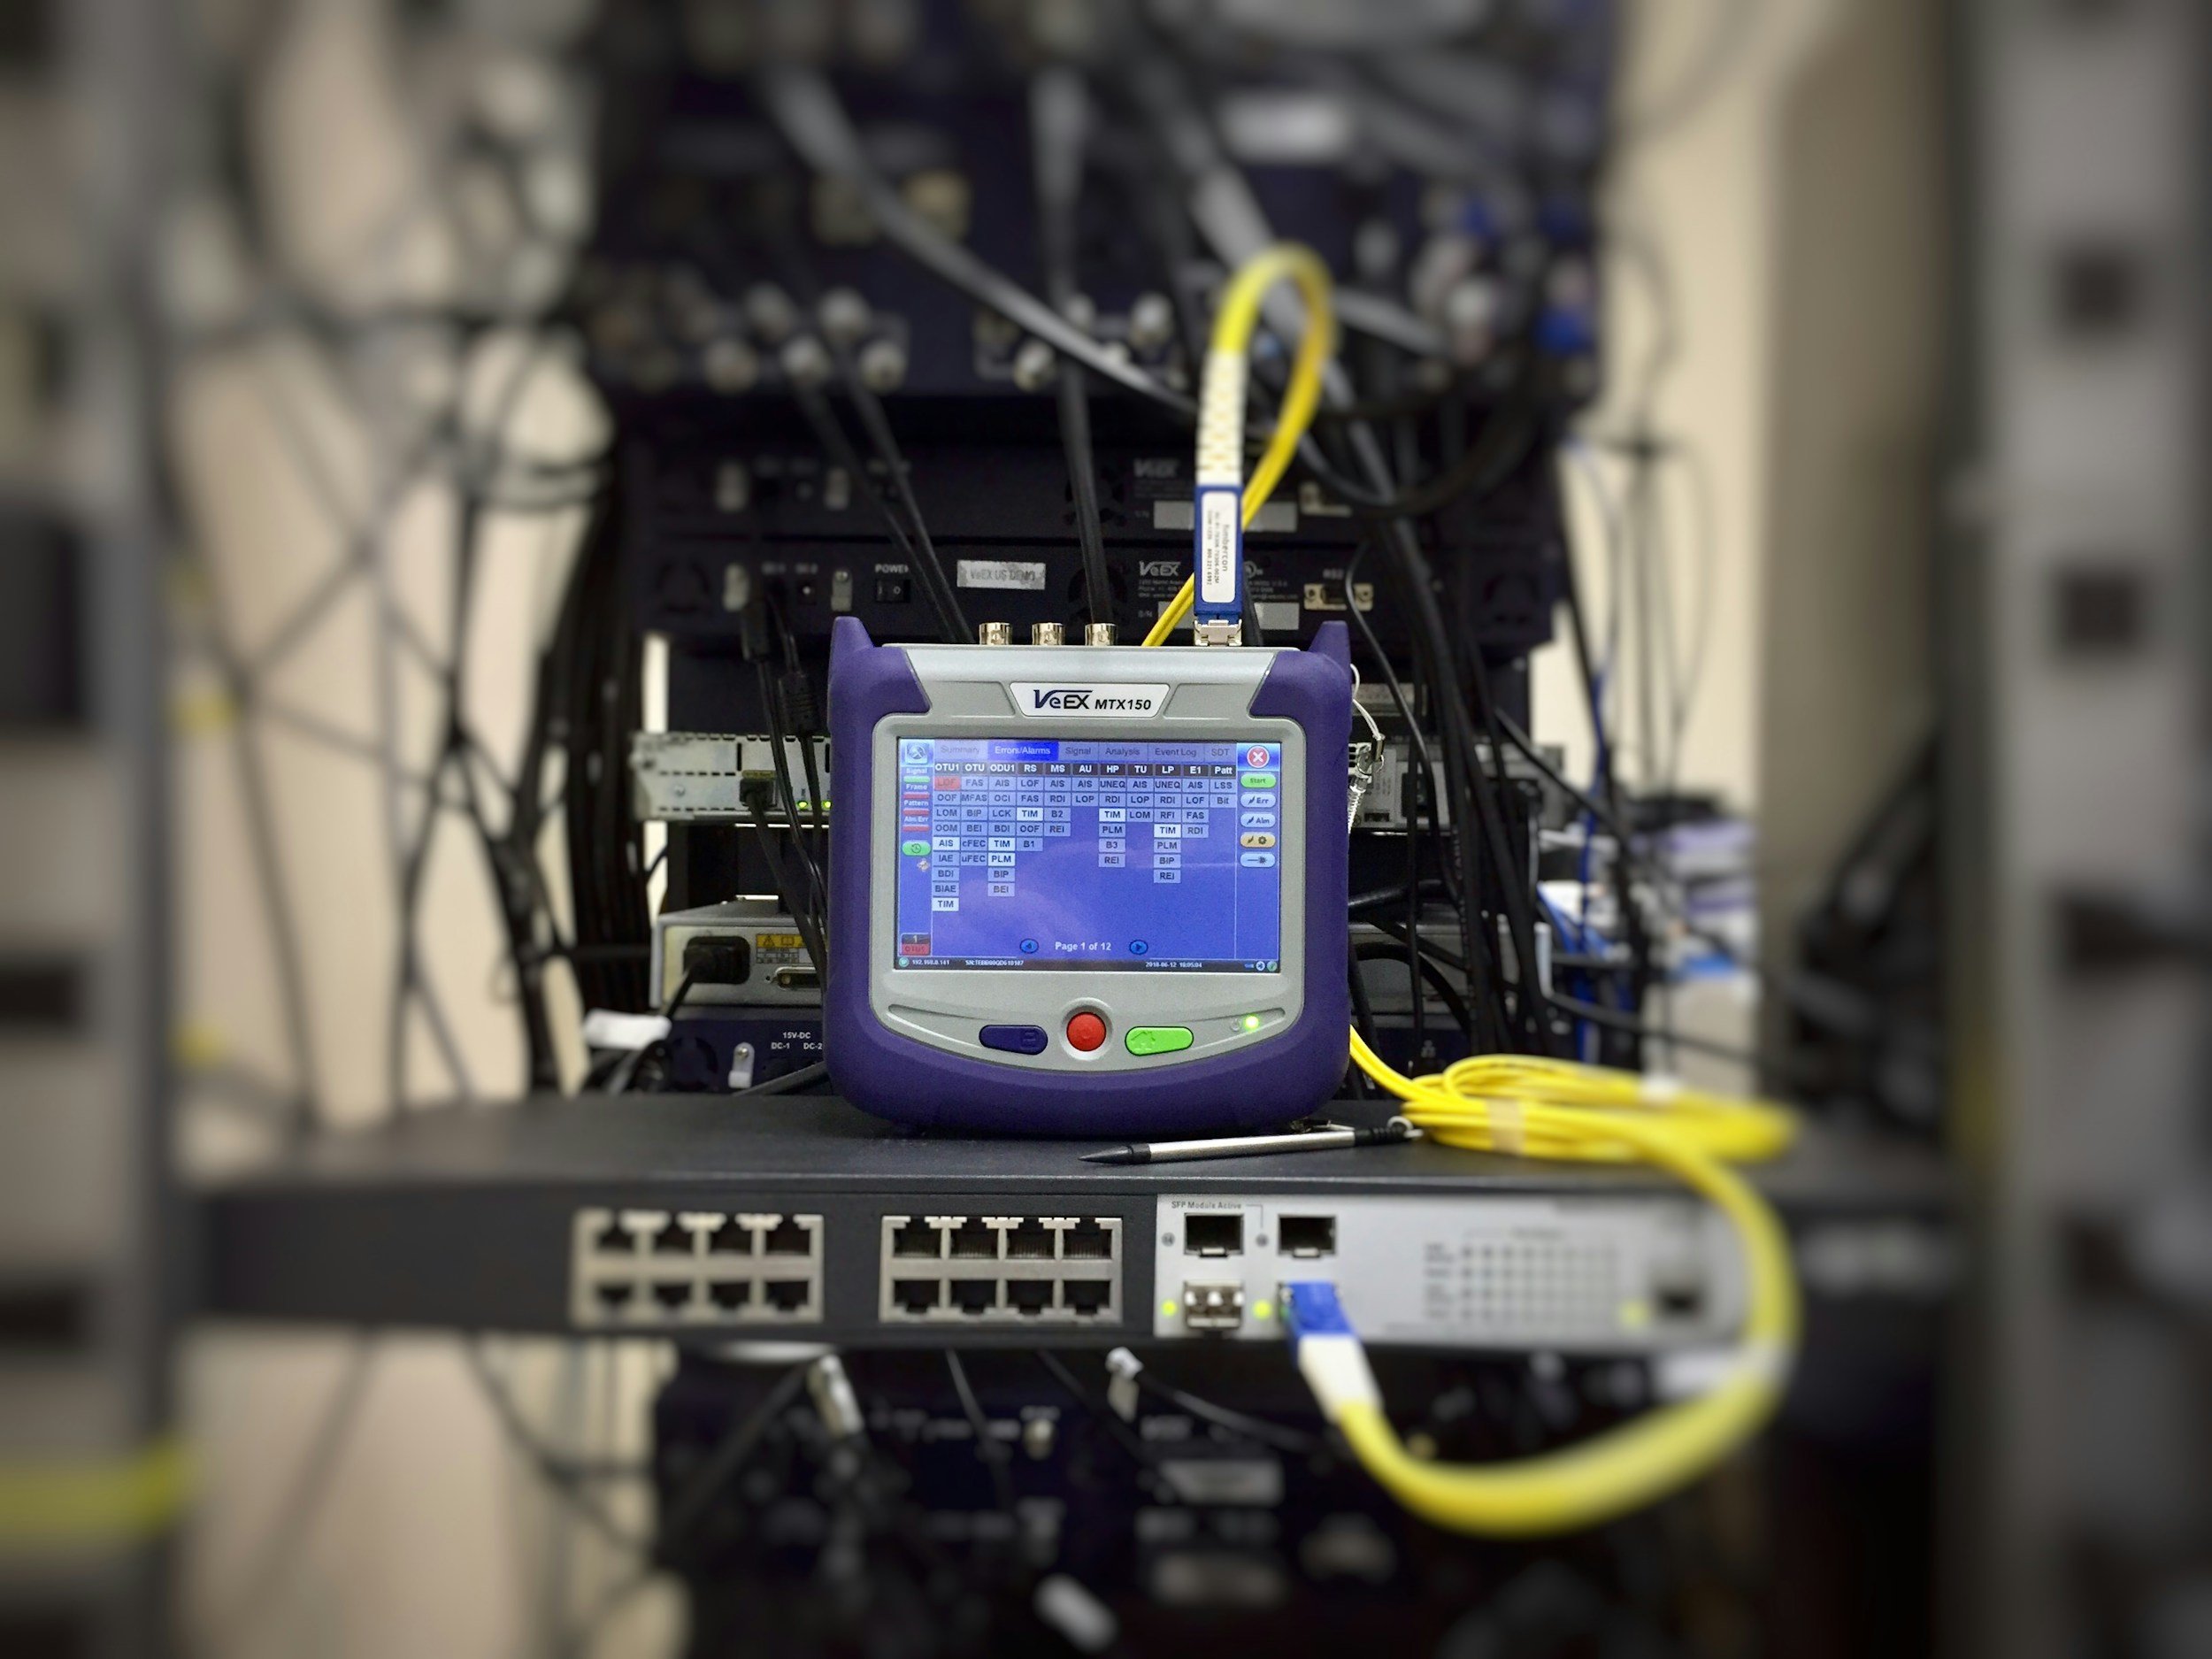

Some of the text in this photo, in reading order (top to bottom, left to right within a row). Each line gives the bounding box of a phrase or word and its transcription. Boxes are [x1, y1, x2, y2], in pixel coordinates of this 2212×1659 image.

[1033, 689, 1151, 710] VeEX MTX150
[1065, 747, 1092, 756] Signal
[1181, 749, 1197, 757] Log
[1056, 941, 1078, 950] Page
[1101, 942, 1111, 951] 12
